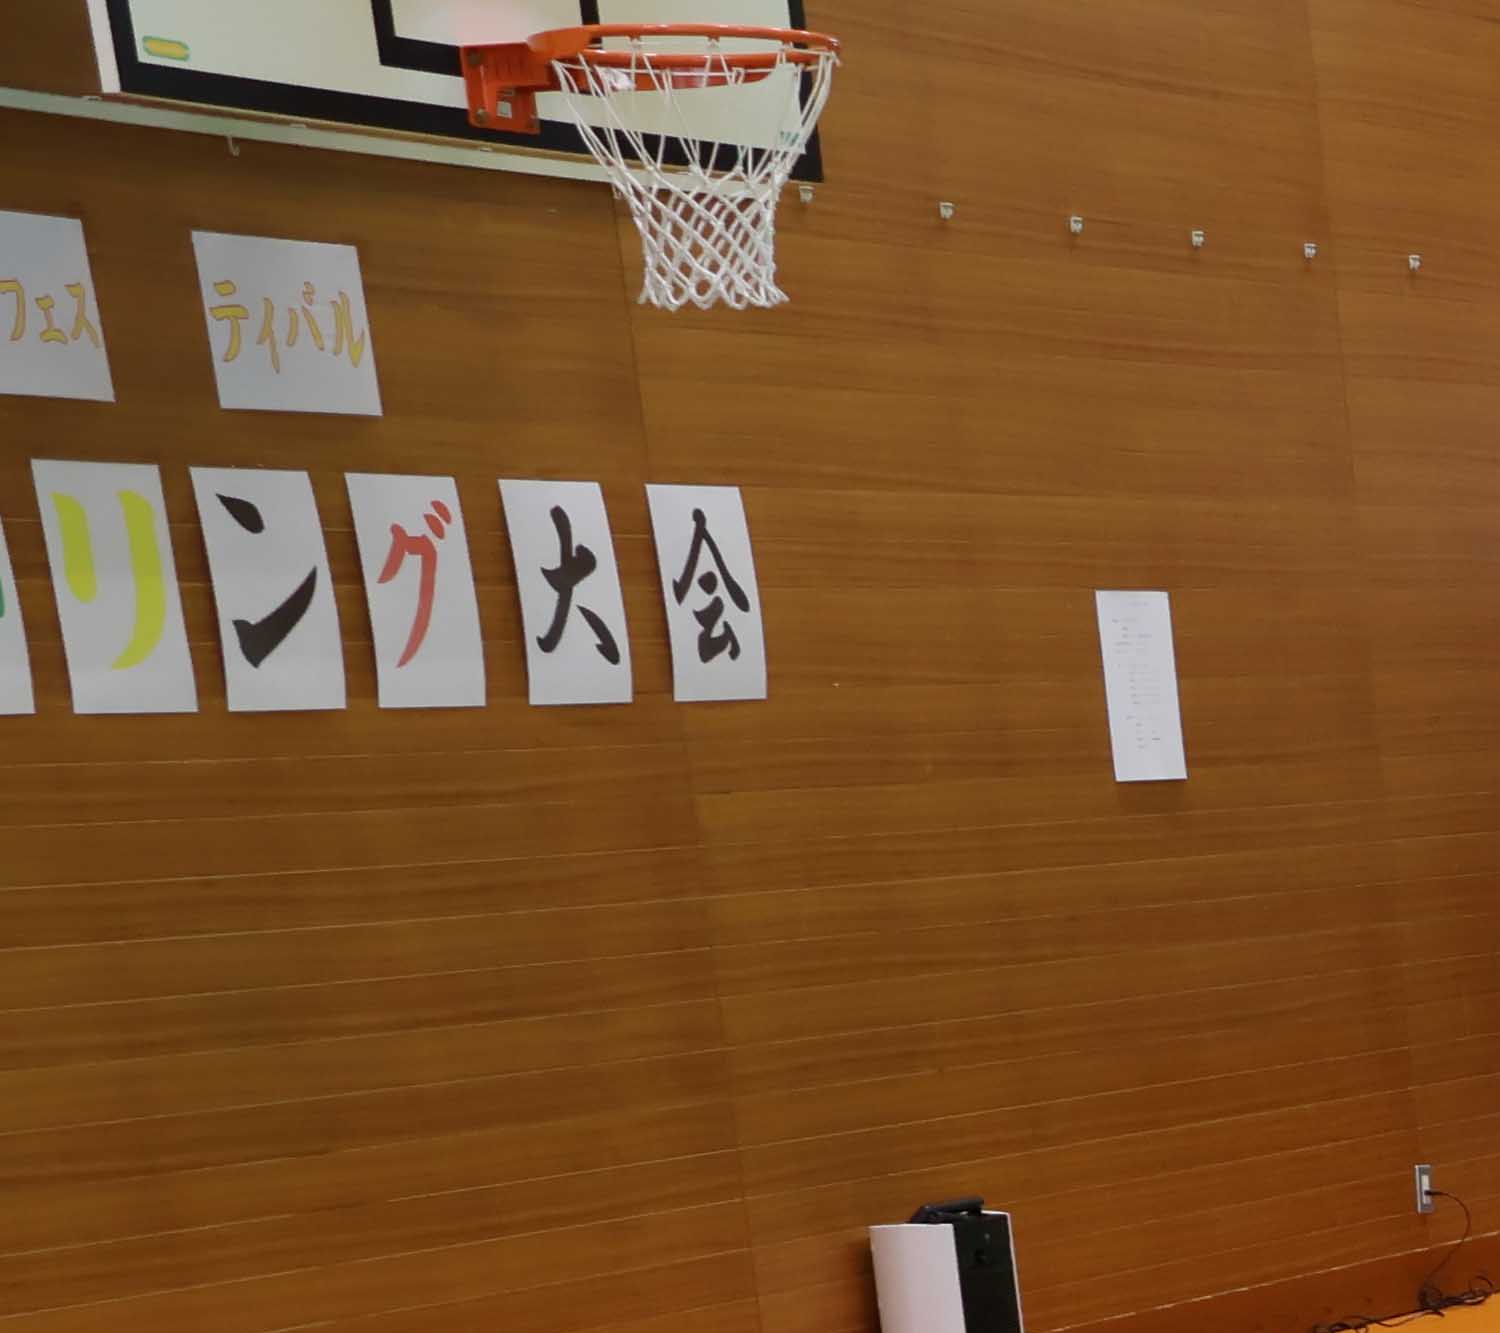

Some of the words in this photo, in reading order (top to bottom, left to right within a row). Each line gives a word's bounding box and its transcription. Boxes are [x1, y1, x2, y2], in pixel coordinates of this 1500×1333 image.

[0, 490, 751, 669] リング大会
